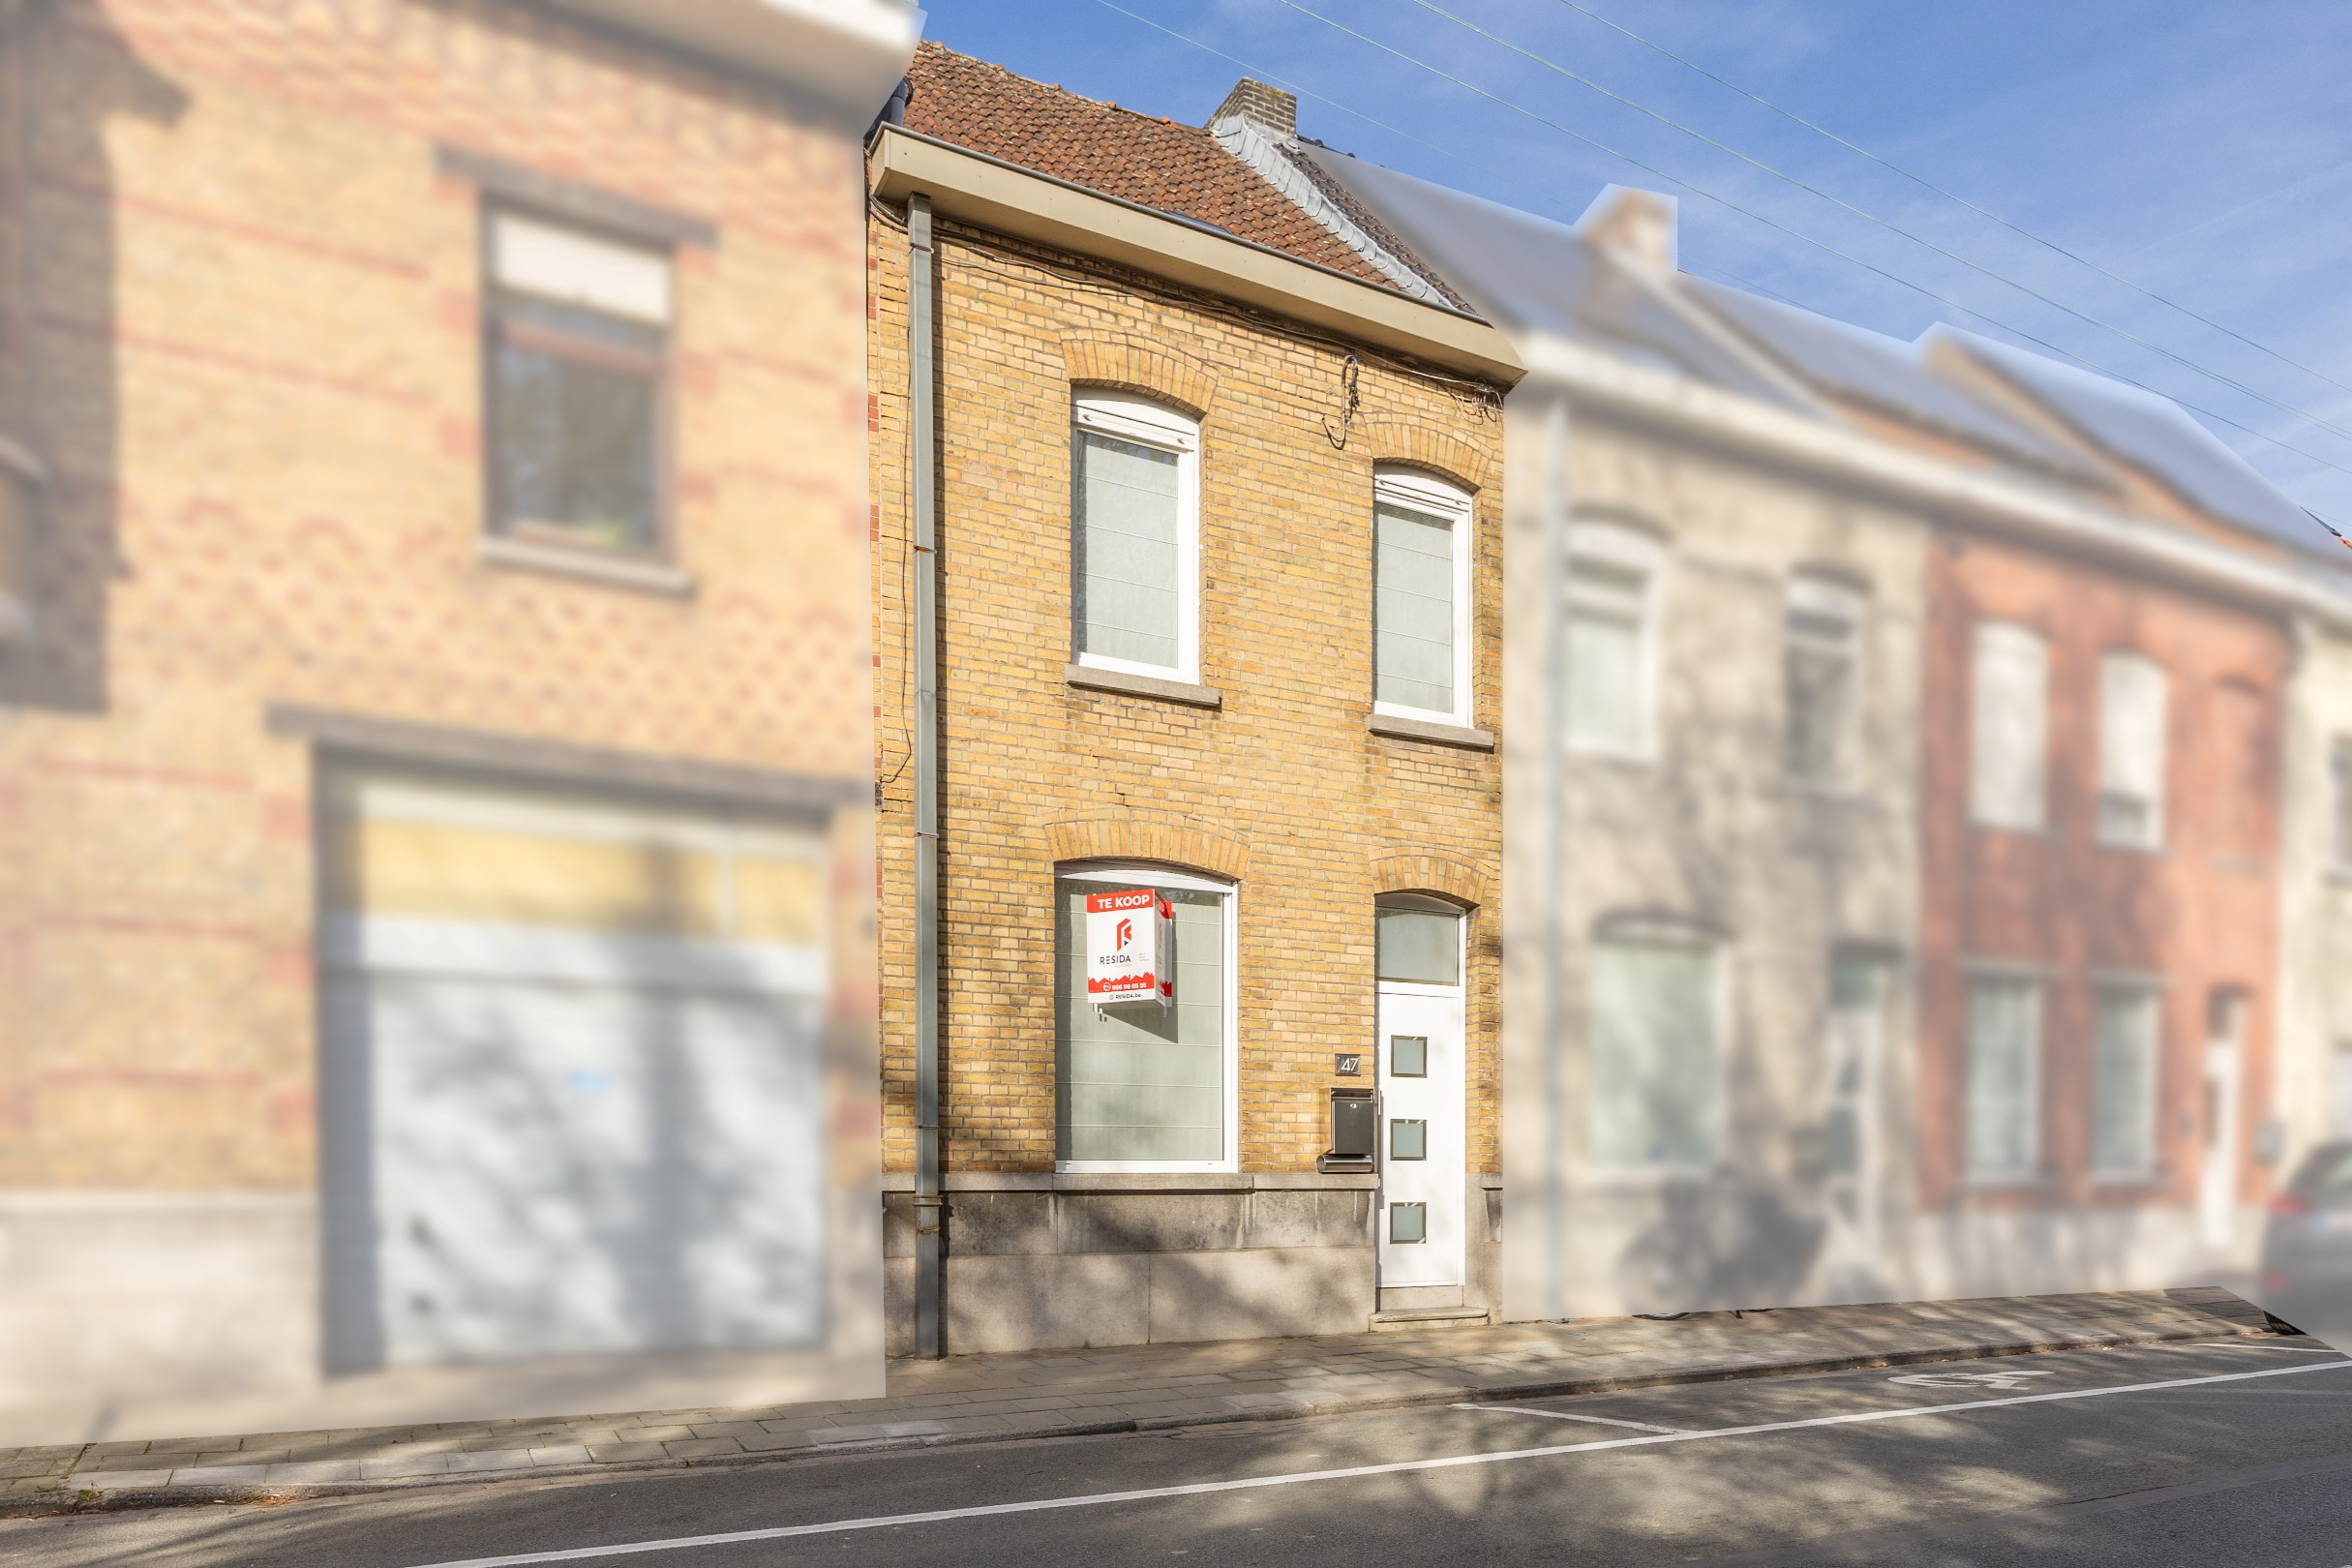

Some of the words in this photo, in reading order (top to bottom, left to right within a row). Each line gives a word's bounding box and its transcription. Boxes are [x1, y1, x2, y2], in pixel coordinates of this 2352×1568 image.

[1098, 898, 1112, 909] TE
[1115, 895, 1150, 907] KOOP
[1100, 954, 1131, 965] RESIDA
[1341, 1058, 1359, 1071] 47
